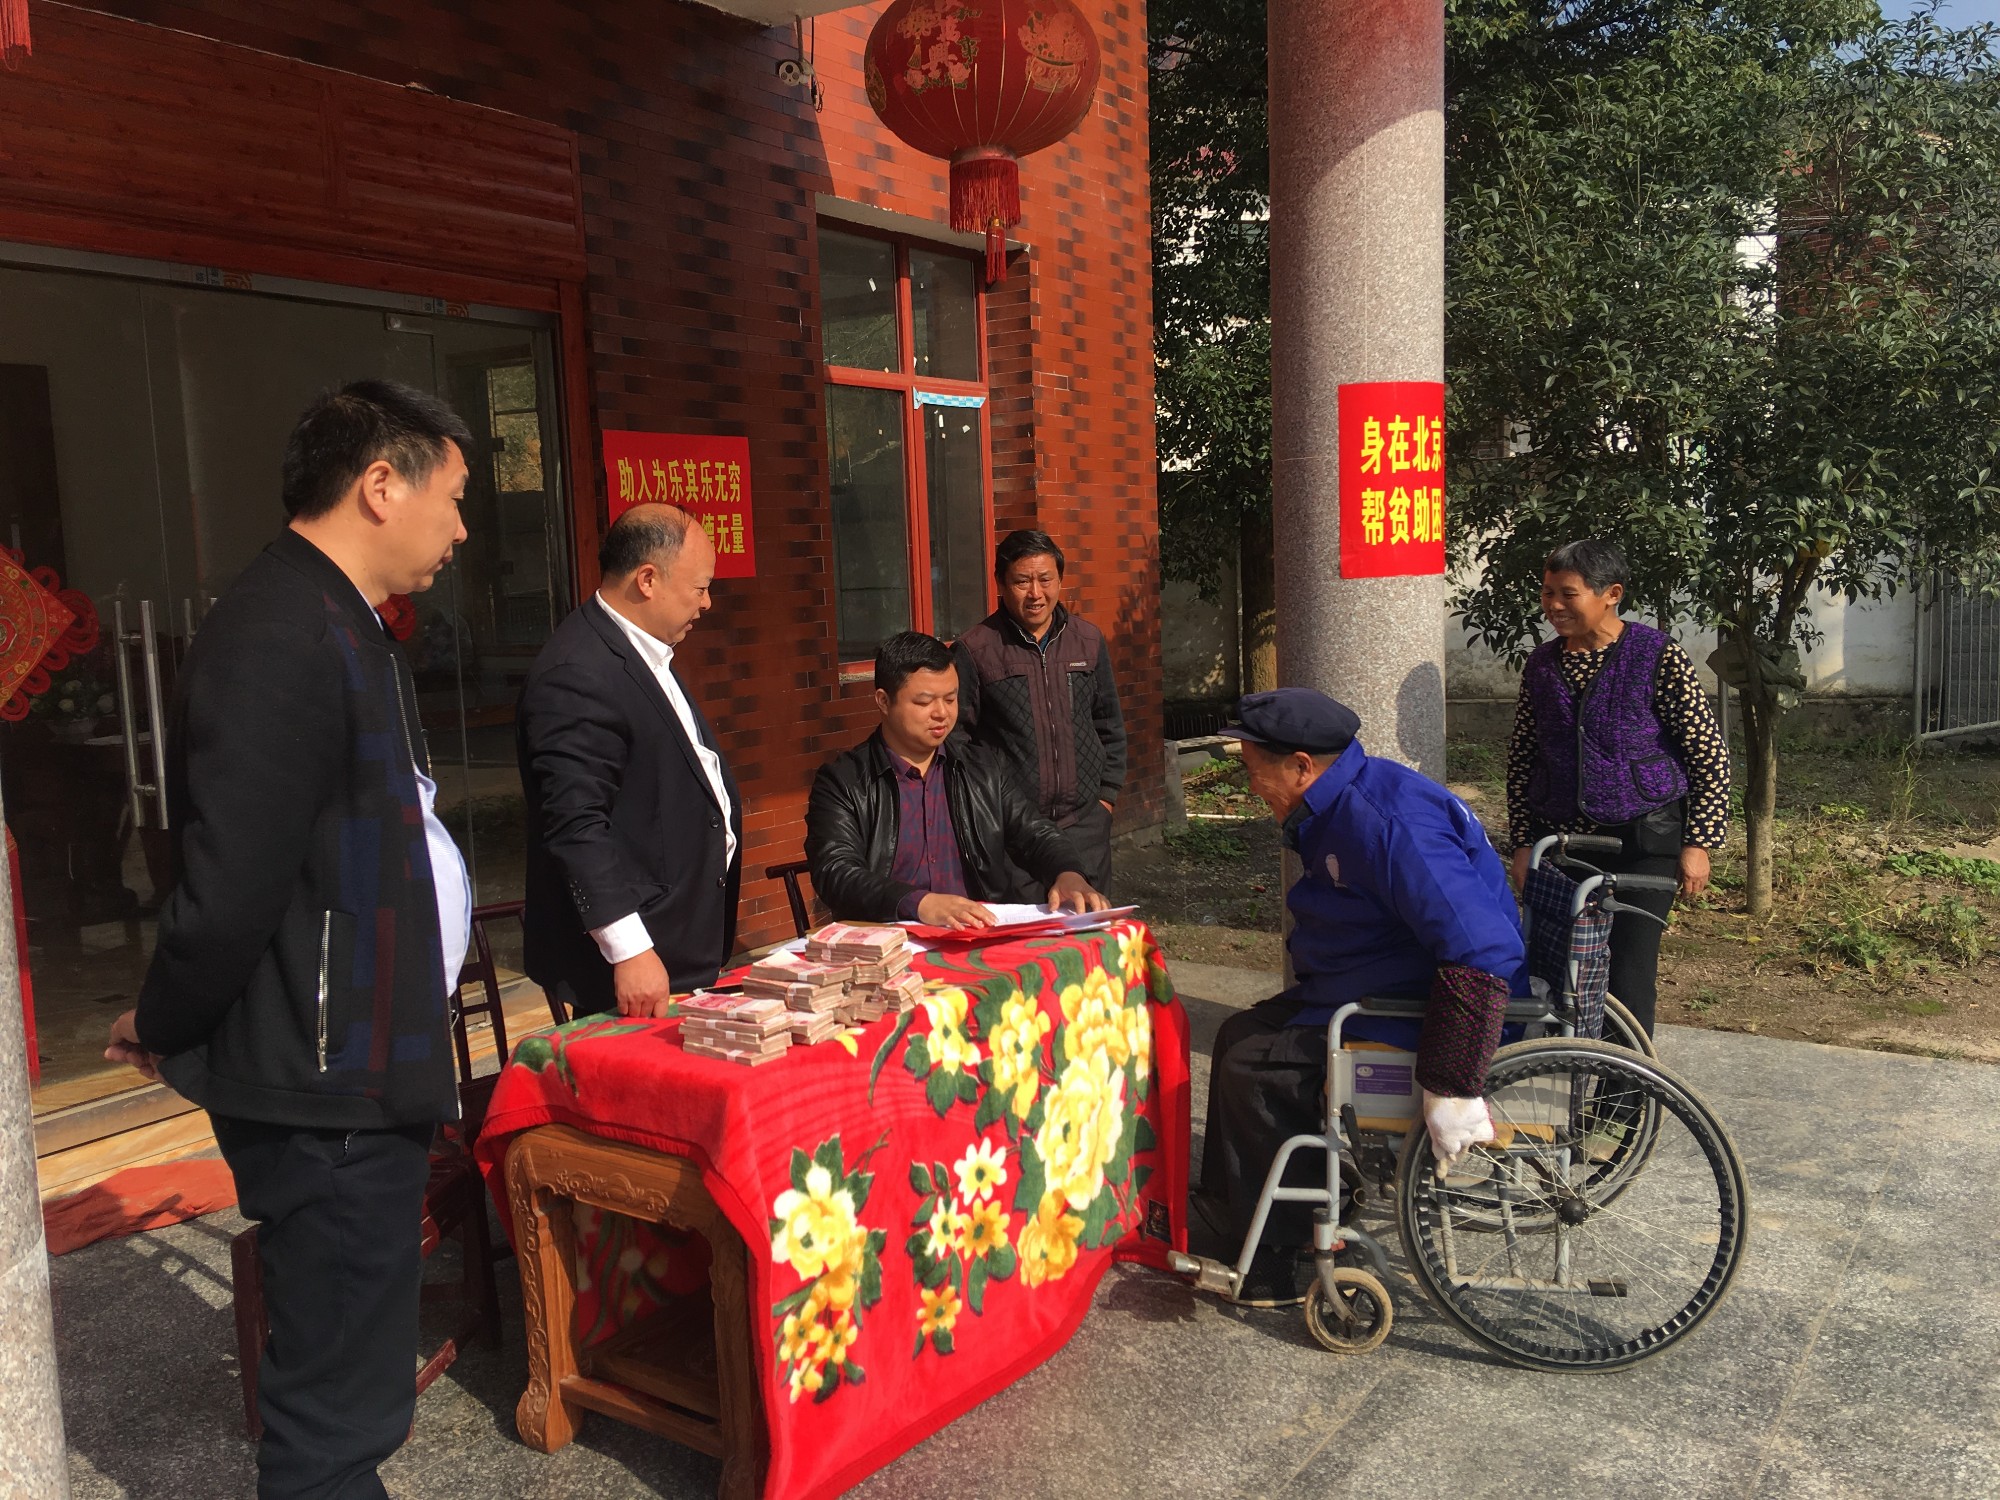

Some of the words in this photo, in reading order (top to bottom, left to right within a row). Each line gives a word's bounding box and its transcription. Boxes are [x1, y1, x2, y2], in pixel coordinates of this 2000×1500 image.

[1361, 415, 1441, 475] 身在北京
[617, 456, 741, 502] 助人为乐其乐无穷
[693, 511, 746, 554] 德无量
[1361, 486, 1443, 546] 帮贫助困
